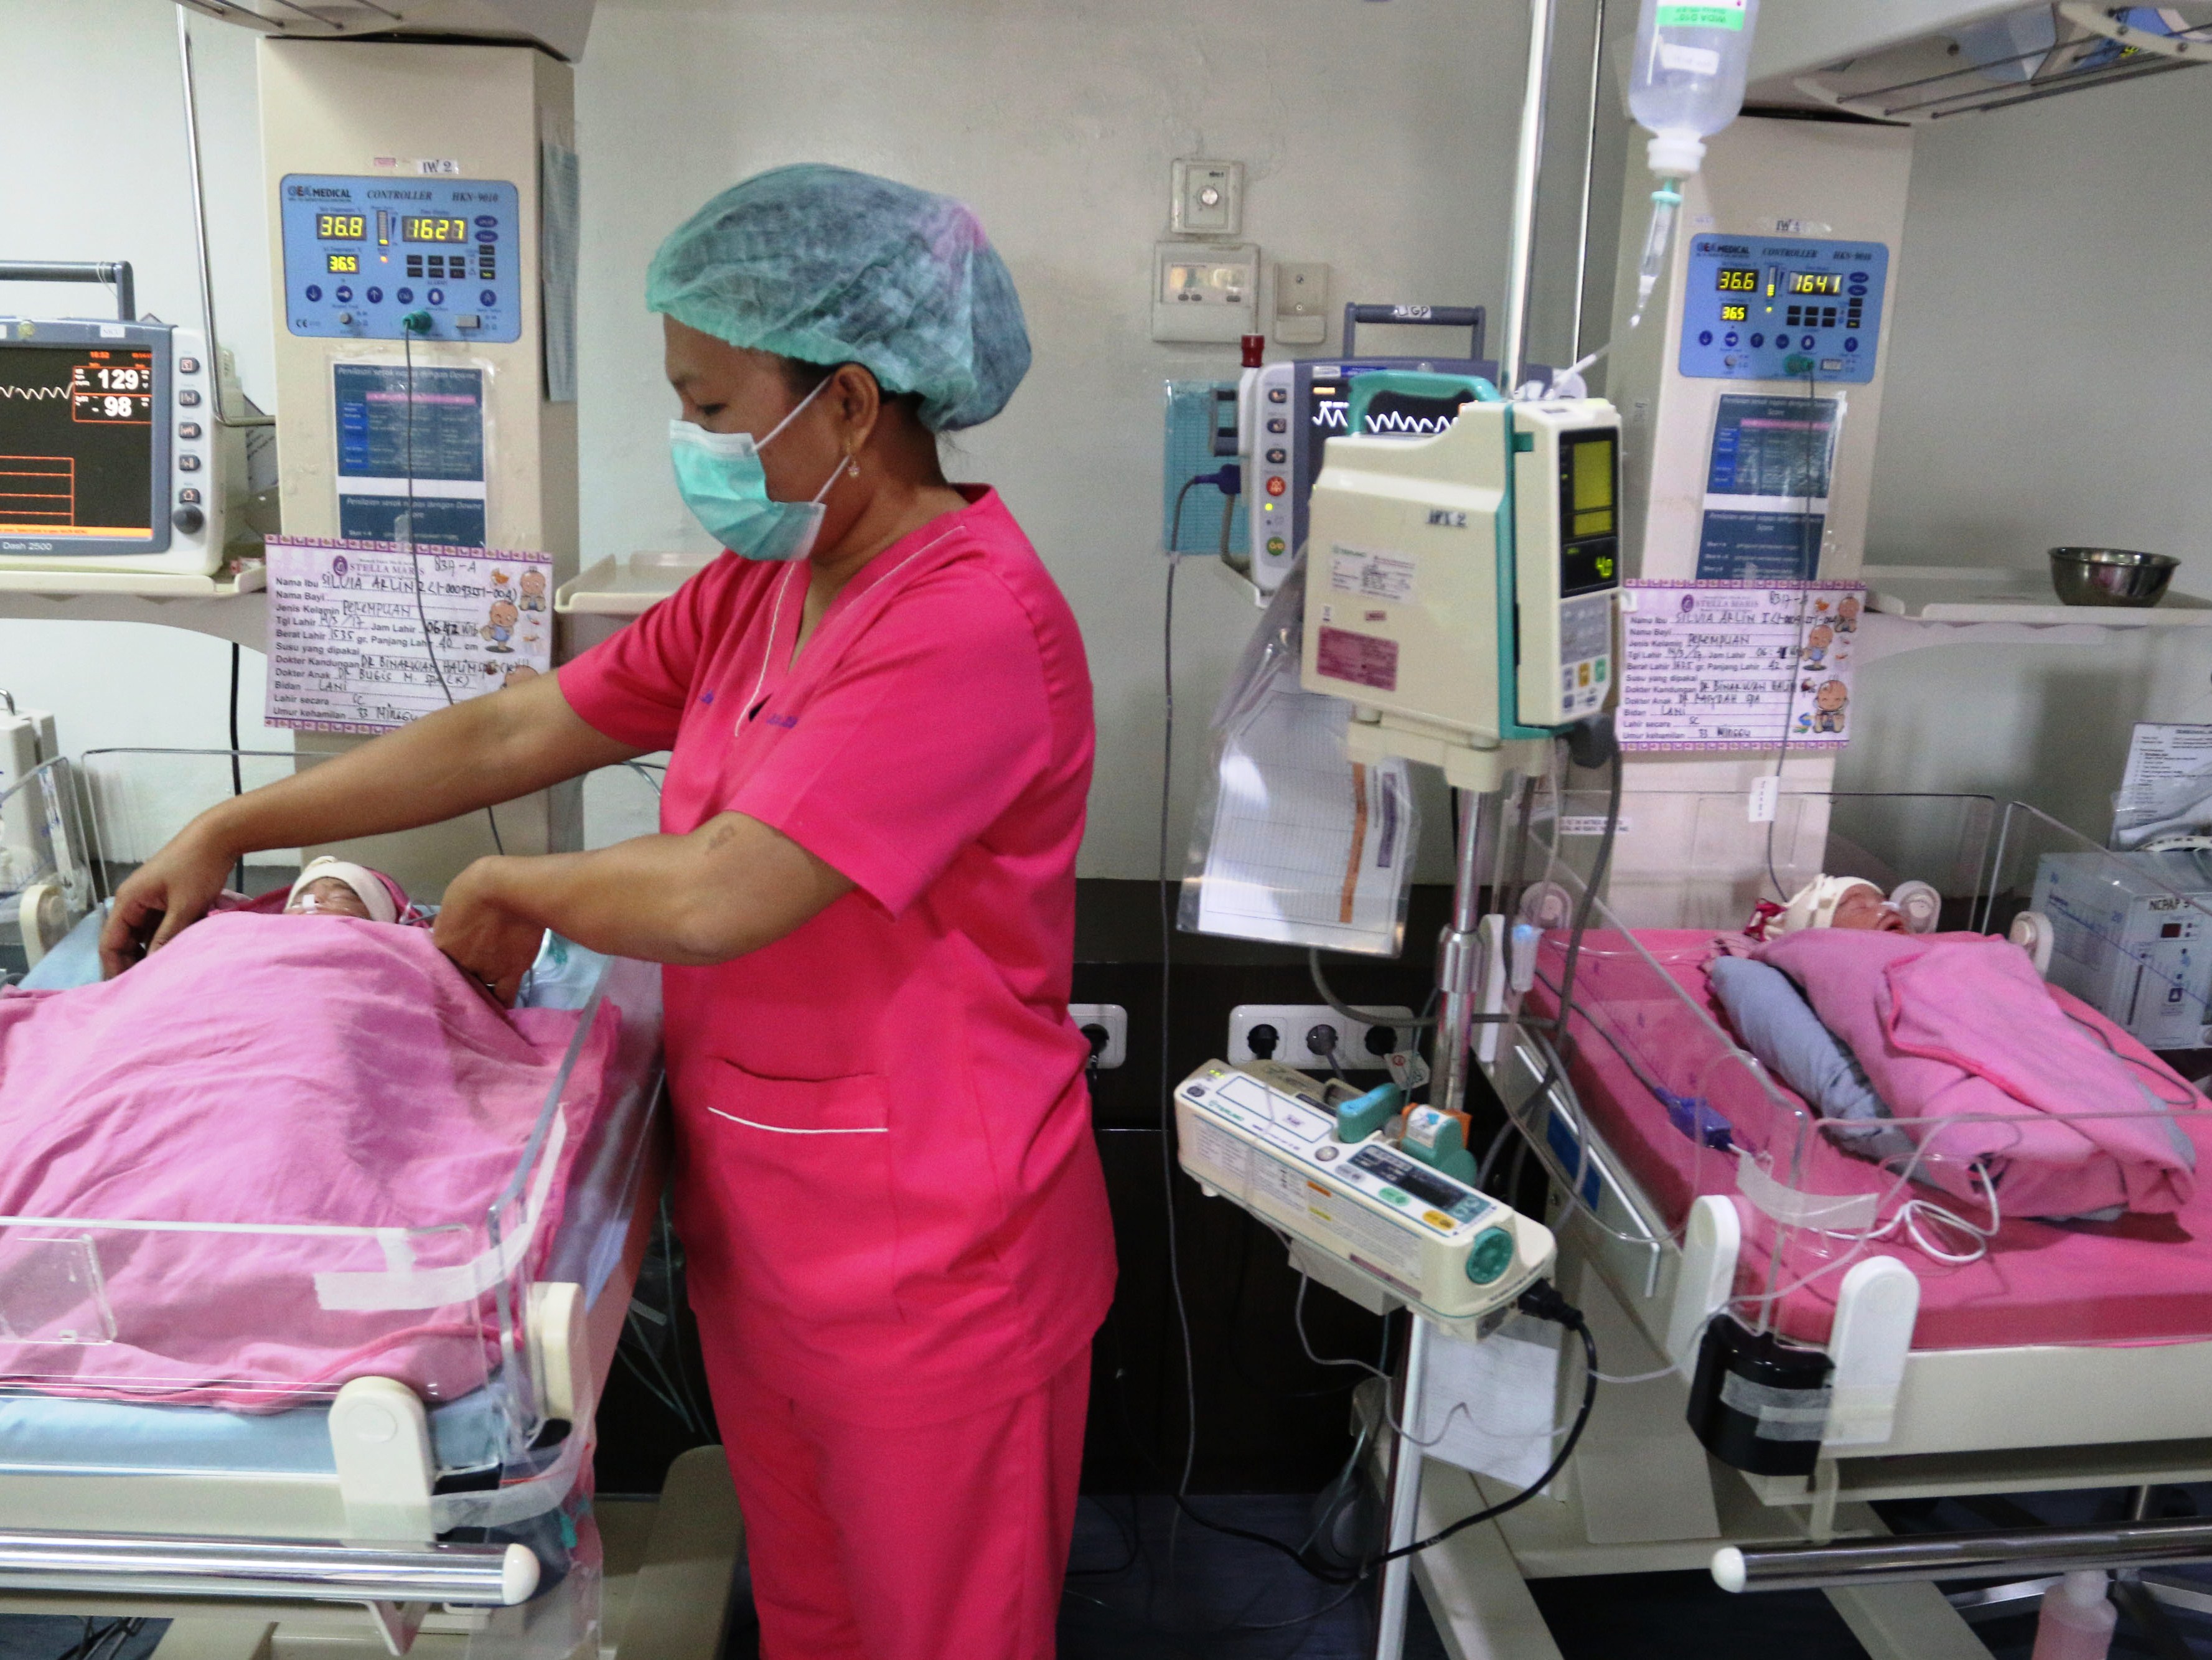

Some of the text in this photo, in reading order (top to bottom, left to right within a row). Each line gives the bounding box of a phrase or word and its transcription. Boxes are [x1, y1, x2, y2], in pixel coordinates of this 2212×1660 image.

[444, 161, 452, 172] 2
[313, 189, 352, 198] MEDICAL
[367, 190, 432, 200] CONTROLLER
[1717, 245, 1750, 254] MEDICAL
[1762, 248, 1819, 258] CONTROLLER
[98, 368, 139, 390] 129
[104, 396, 132, 417] 98
[28, 542, 52, 550] 2500
[350, 562, 424, 575] STELLA MARS
[276, 578, 319, 588] Nama Ibu
[276, 591, 325, 602] Nama Bayi
[276, 604, 340, 615] Jenis Kelamin
[276, 617, 316, 626] Tgl Lahir
[371, 623, 415, 633] Jam Lahir
[1654, 628, 1671, 637] Bayi
[276, 629, 326, 640] Berat Lahir
[371, 635, 408, 647] Panjang
[276, 642, 360, 655] Susu yang dipakai
[276, 655, 360, 669] Dokter Kandungan
[275, 668, 330, 678] Dokter Anak
[274, 681, 301, 690] Bidan
[274, 694, 329, 705] Lahir secara
[273, 706, 346, 719] Umur kehamilan
